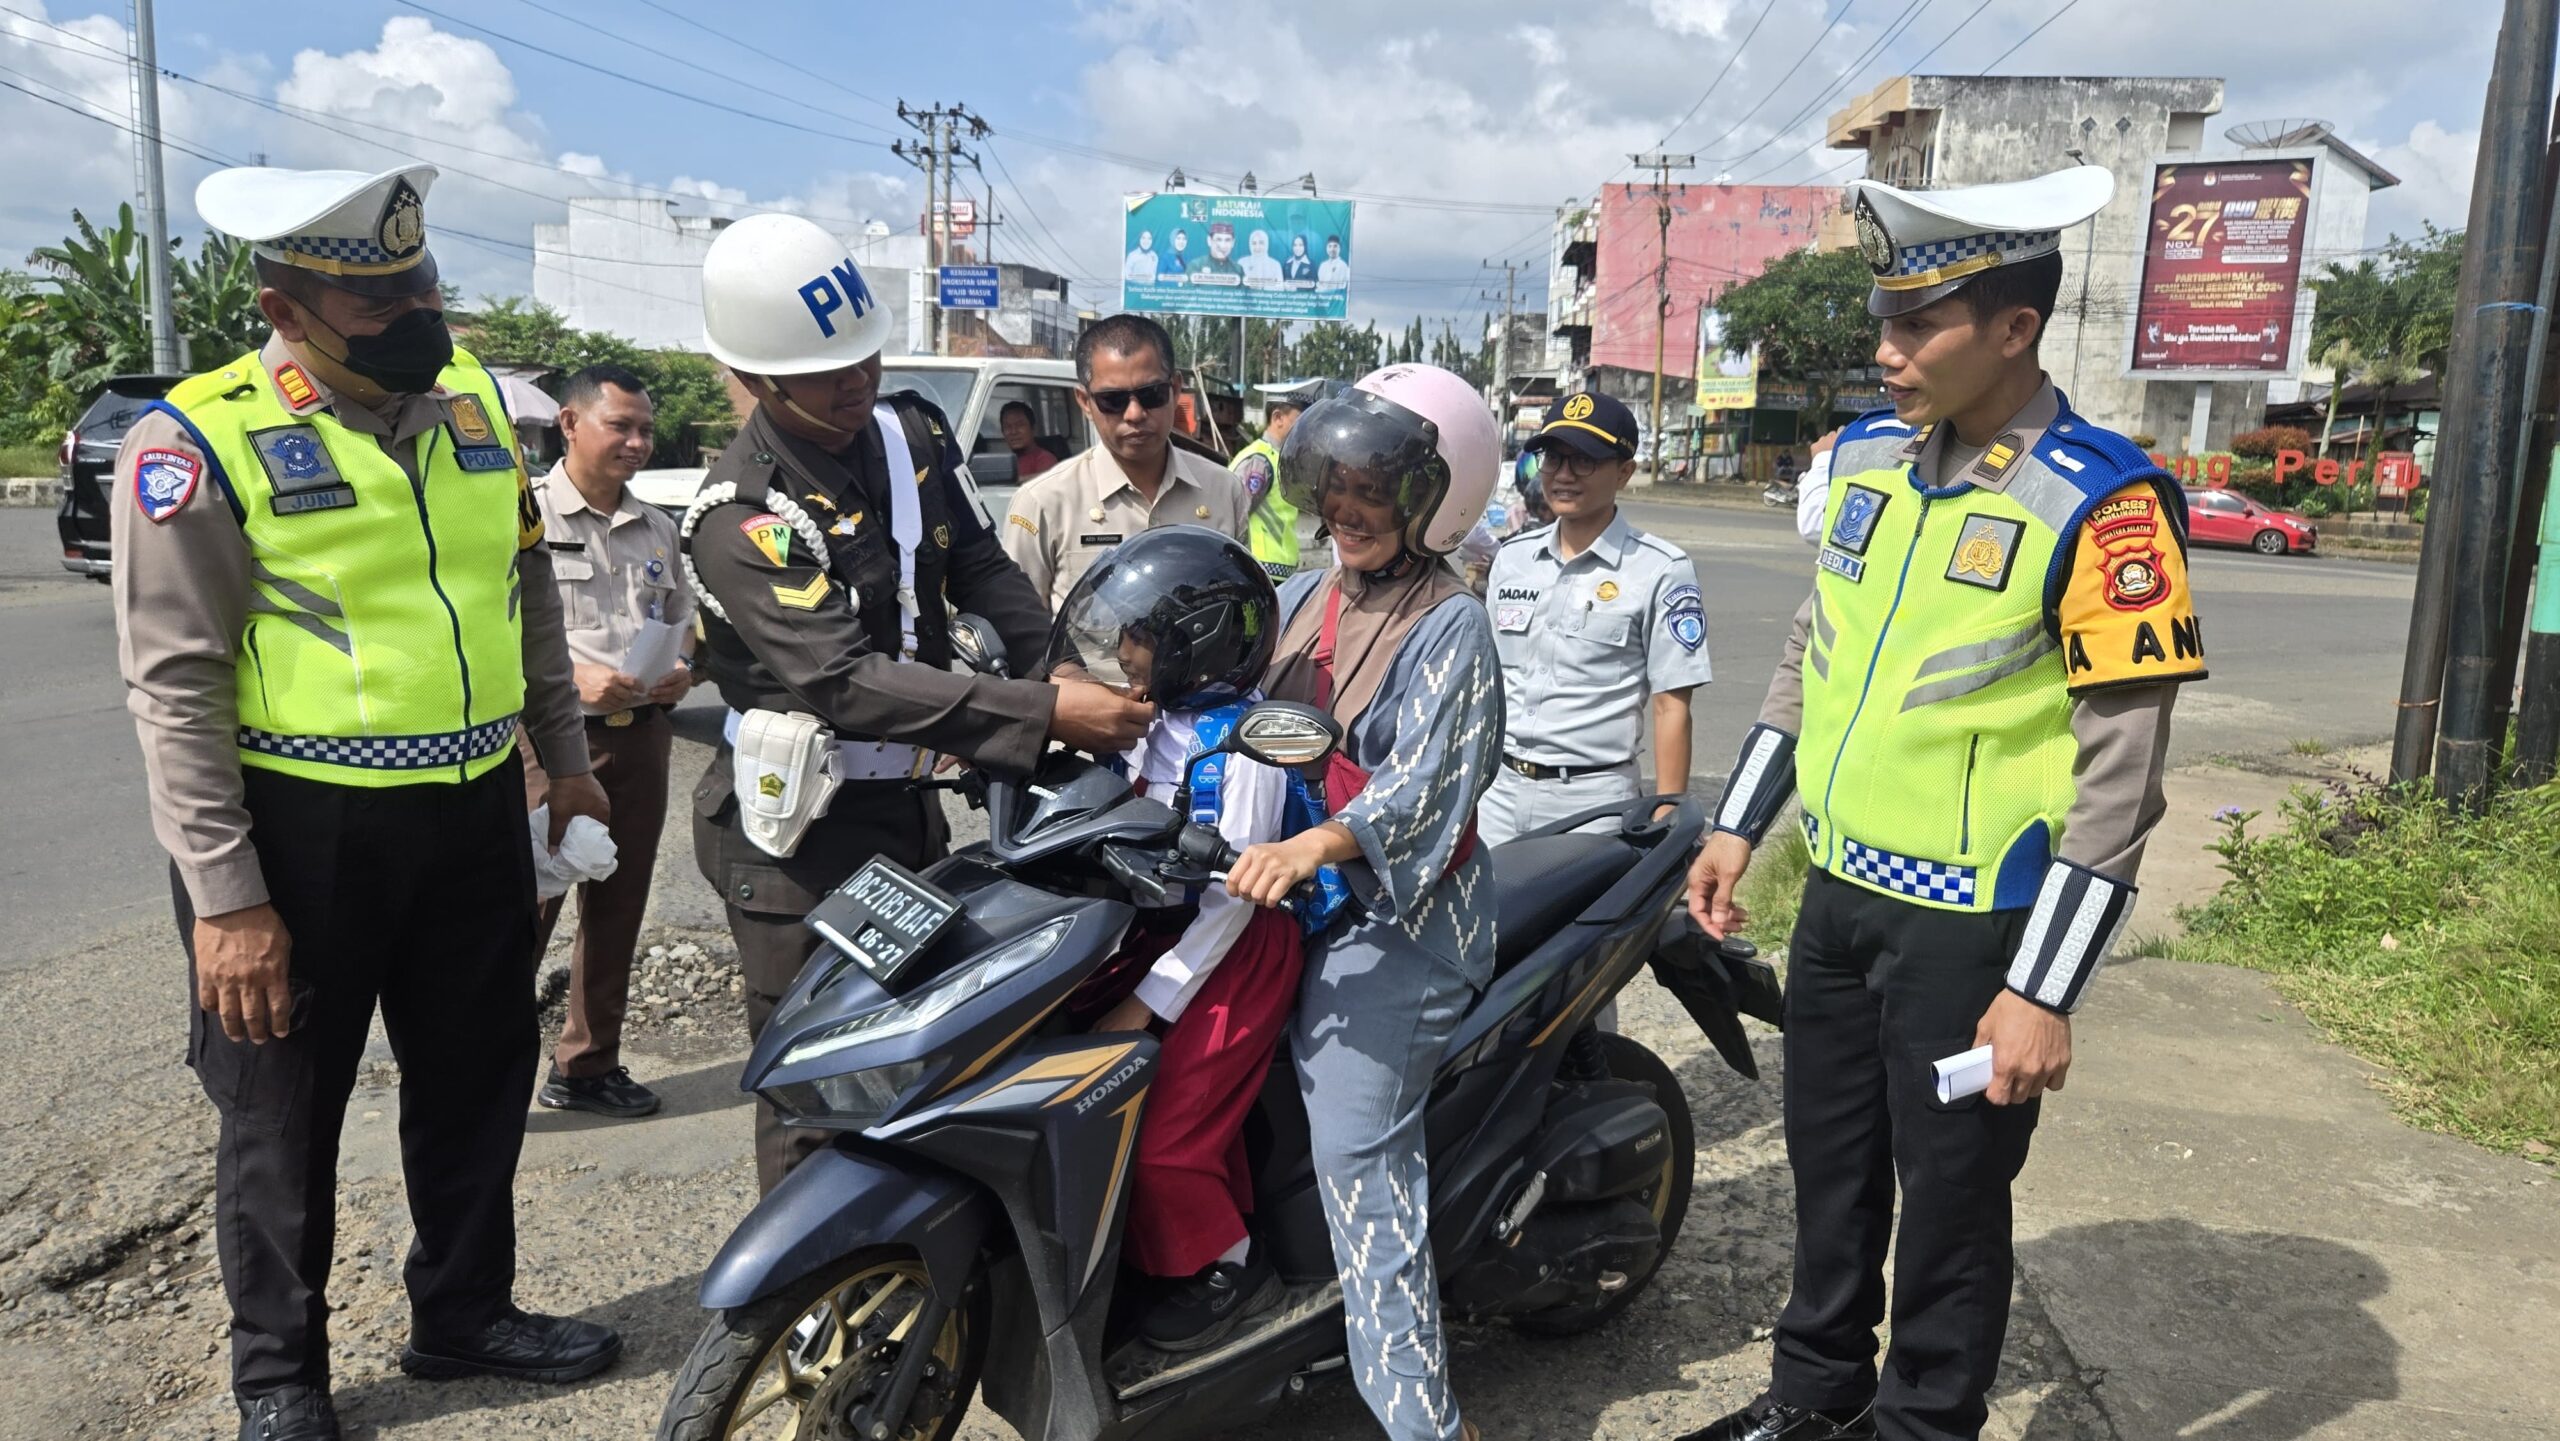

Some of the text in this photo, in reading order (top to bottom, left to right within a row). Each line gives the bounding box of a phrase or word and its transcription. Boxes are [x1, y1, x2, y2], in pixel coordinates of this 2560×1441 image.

[1216, 200, 1261, 210] SATUKAN
[1212, 208, 1265, 218] INDONESIA
[2168, 204, 2220, 247] 27
[2165, 241, 2193, 249] NOV
[949, 269, 989, 277] KENDARAAN
[2232, 271, 2264, 281] DALAM
[942, 278, 997, 287] ANGKUTAN UMUM
[2205, 282, 2254, 292] SERENTAK
[946, 288, 991, 297] WAJIB MASUK
[798, 257, 875, 339] PM
[2188, 324, 2237, 334] Terima Kasih
[2189, 333, 2228, 342] Sumatera
[464, 452, 511, 467] POLISI
[291, 493, 338, 510] JUNI
[2092, 500, 2149, 521] POLRES
[2095, 509, 2149, 527] LUBUKLINGGAU
[1498, 588, 1540, 602] DADAN
[863, 881, 913, 920] 2185
[893, 901, 943, 938] HAF
[1074, 1056, 1149, 1115] HONDA
